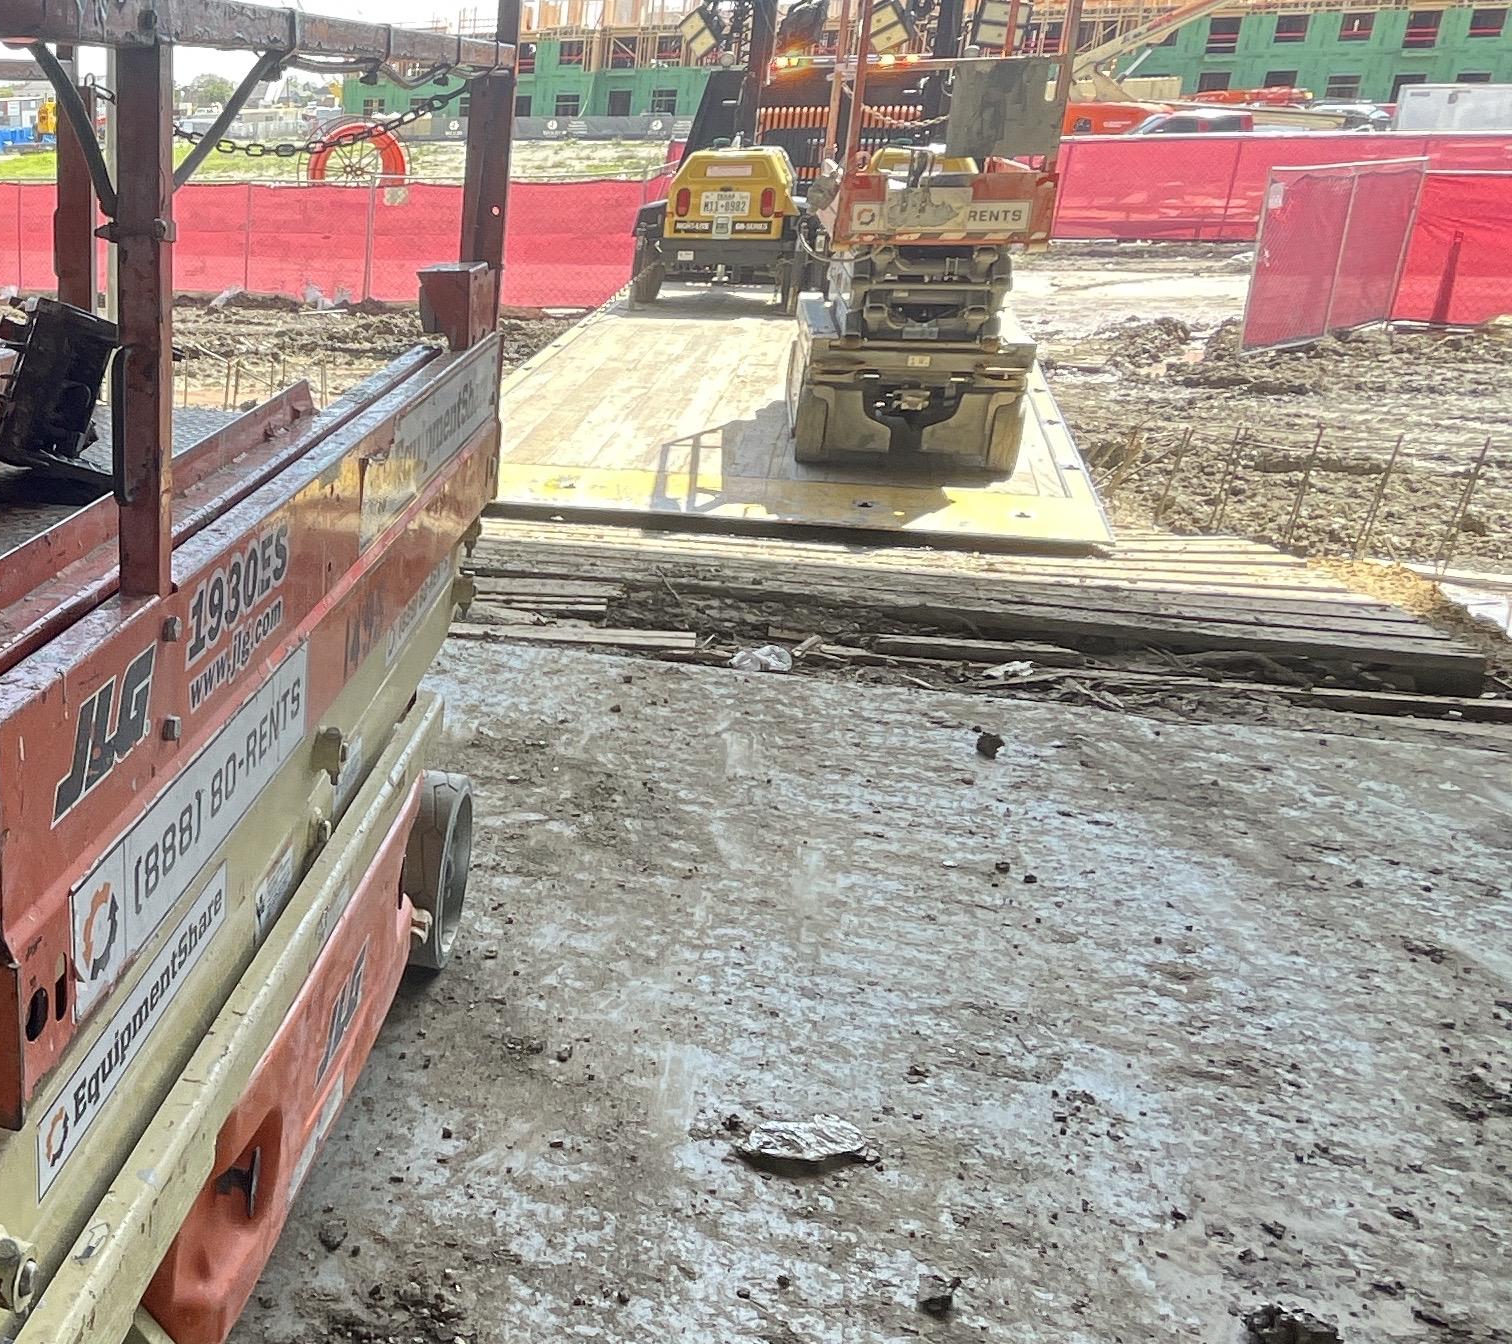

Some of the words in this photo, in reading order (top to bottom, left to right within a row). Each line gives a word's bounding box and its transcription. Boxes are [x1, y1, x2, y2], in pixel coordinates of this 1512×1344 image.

[187, 525, 289, 664] 1930ES
[191, 600, 282, 710] www.jlg.com
[51, 640, 157, 830] JLG
[134, 790, 201, 915] (888)
[211, 677, 302, 818] 80-RENTS
[73, 889, 223, 1127] EquipmentShare
